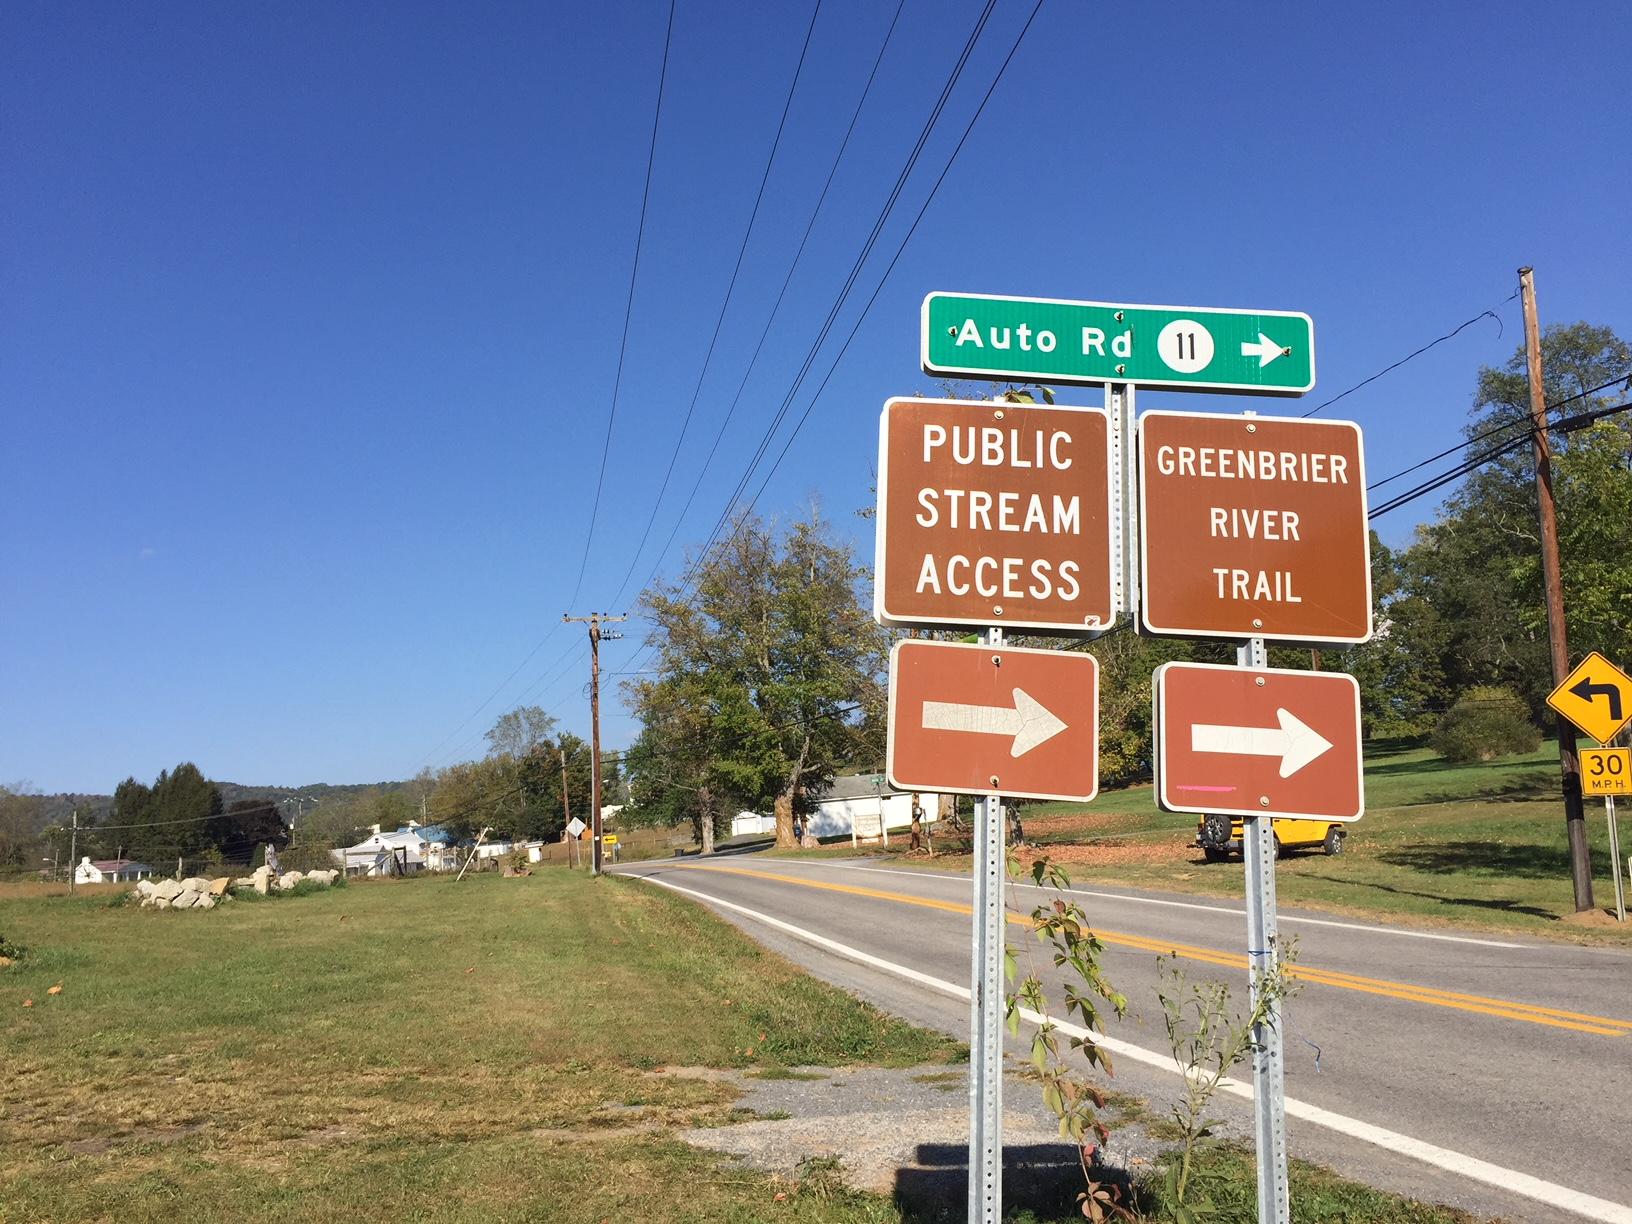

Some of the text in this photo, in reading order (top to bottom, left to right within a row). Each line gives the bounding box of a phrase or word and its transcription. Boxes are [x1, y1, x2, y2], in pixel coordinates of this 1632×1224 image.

[955, 319, 1195, 360] Auto Rd 11
[922, 424, 1072, 470] PUBLIC
[1157, 445, 1348, 484] GREENBRIER
[915, 487, 1081, 535] STREAM
[1210, 507, 1300, 541] RIVER
[915, 553, 1081, 601] ACCESS
[1213, 568, 1302, 603] TRAIL
[1590, 754, 1622, 776] 30
